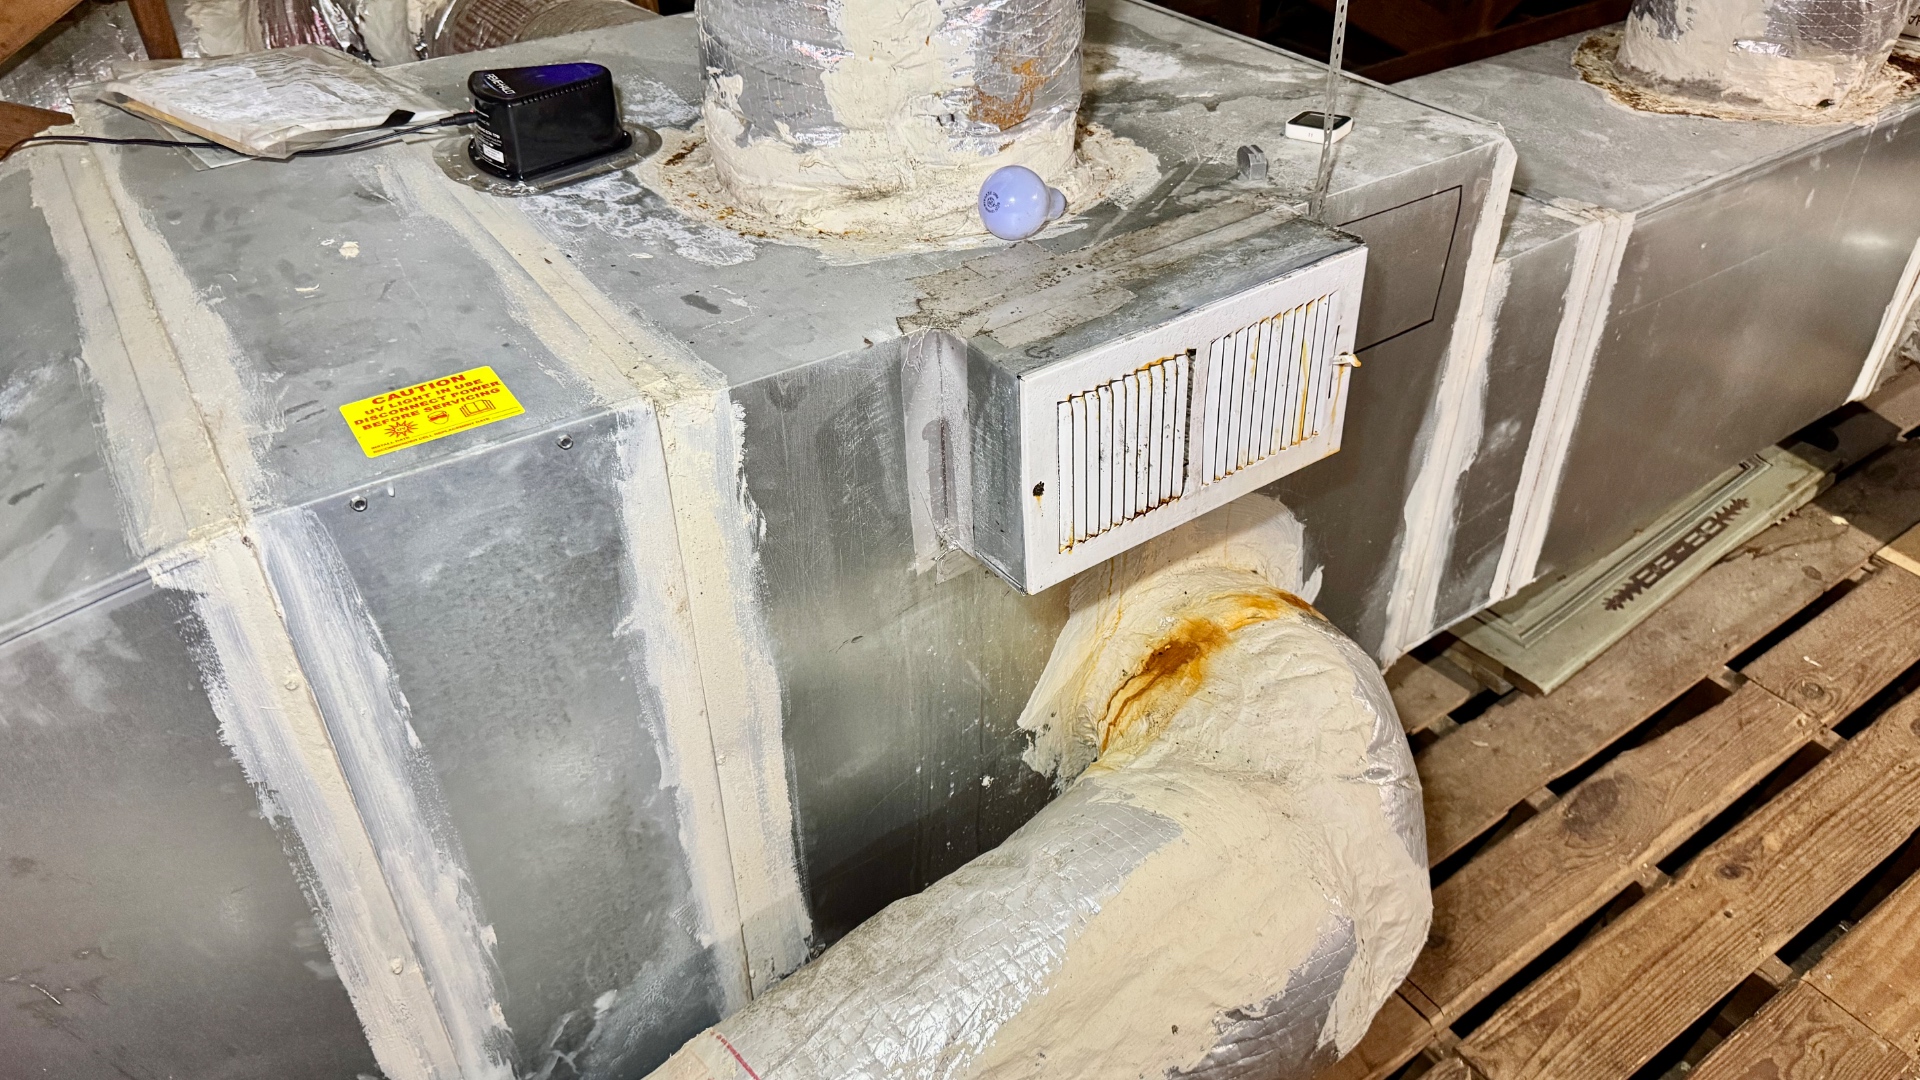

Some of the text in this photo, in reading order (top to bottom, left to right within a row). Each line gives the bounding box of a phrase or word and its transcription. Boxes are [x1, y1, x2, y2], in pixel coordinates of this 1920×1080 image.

[354, 381, 501, 426] DISCONNECT POWER
[364, 378, 482, 415] UV LIGHT IN USE
[372, 374, 466, 405] CAUTION
[362, 387, 501, 431] BEFORE SERVICING
[371, 436, 410, 450] INSTALL DATE
